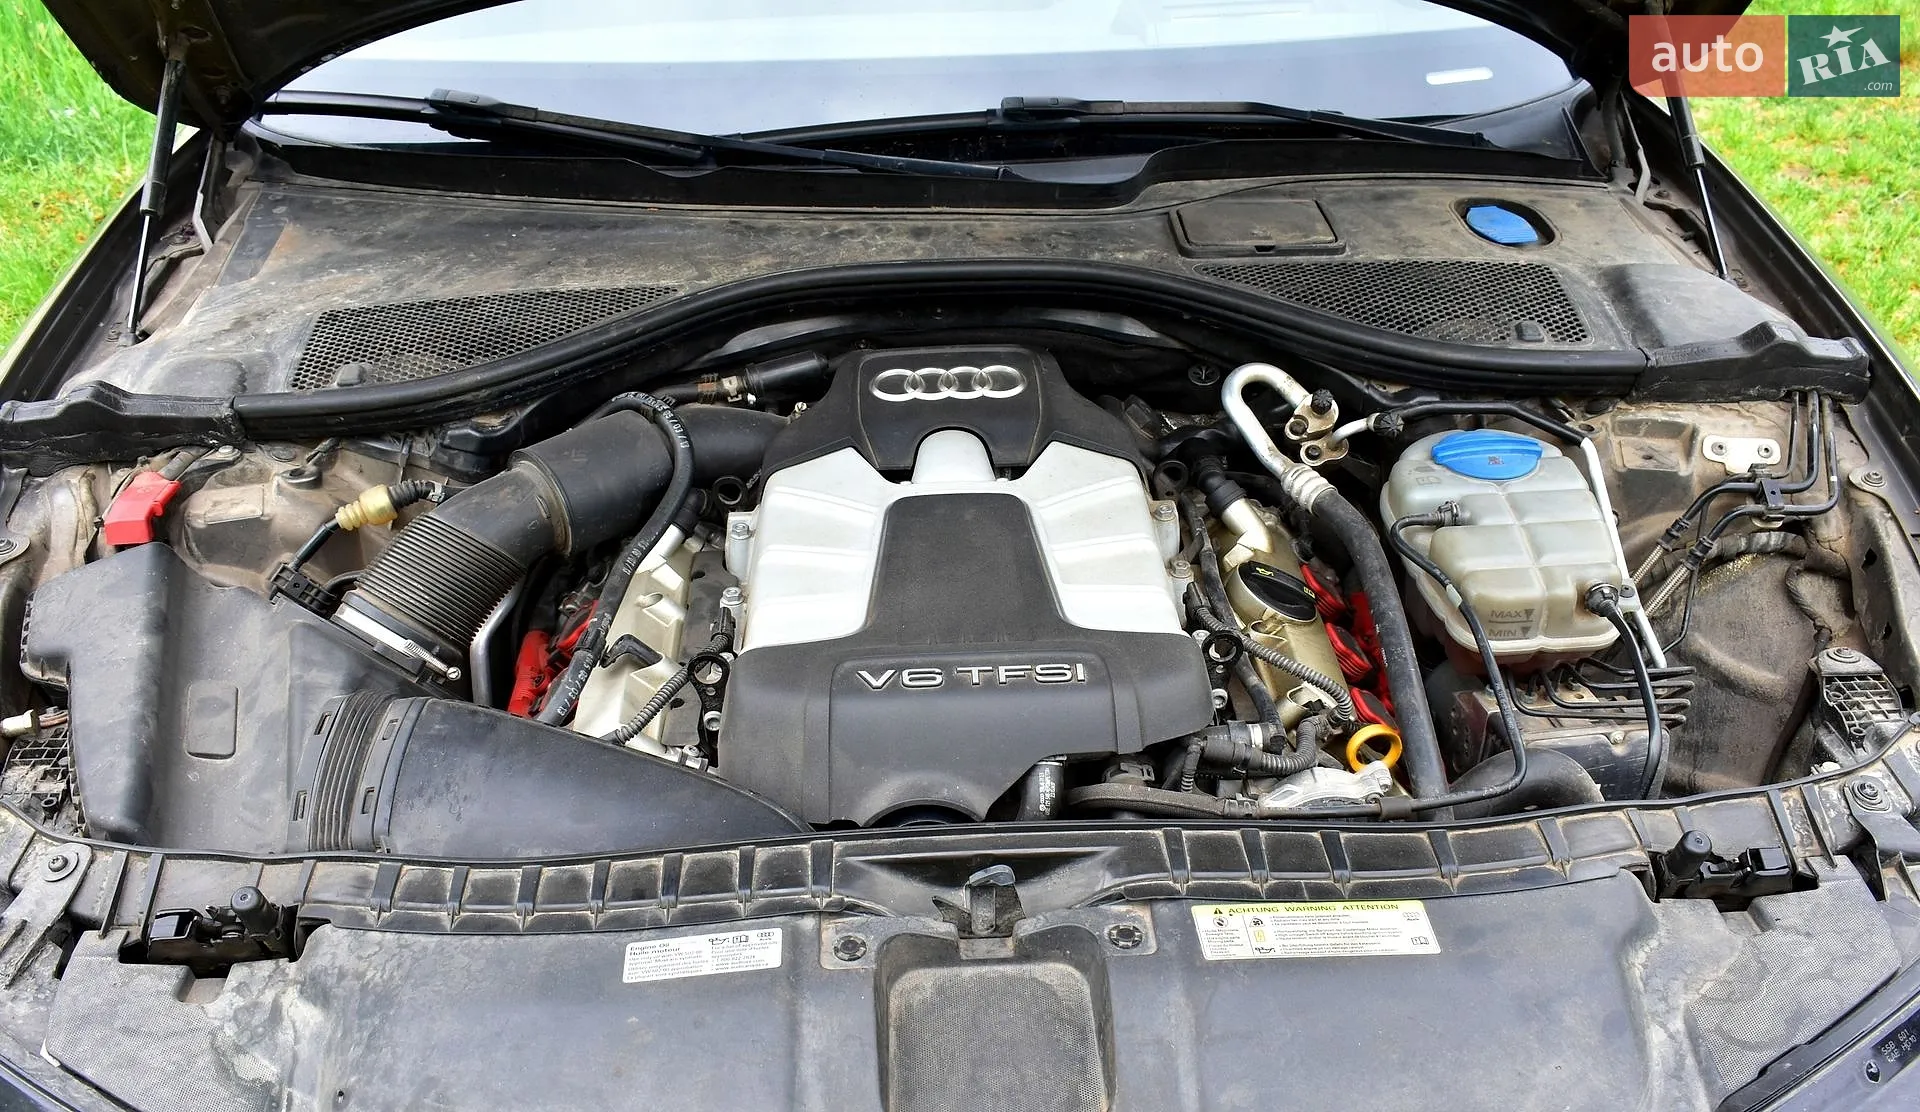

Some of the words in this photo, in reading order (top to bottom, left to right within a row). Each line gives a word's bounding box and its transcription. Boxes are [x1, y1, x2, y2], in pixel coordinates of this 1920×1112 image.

[1490, 609, 1522, 618] MAX
[1488, 629, 1517, 637] MIN
[856, 667, 944, 690] V6
[955, 663, 1088, 685] TFSI
[1228, 906, 1279, 914] ACHTUNG
[1342, 903, 1399, 911] ATTENTION
